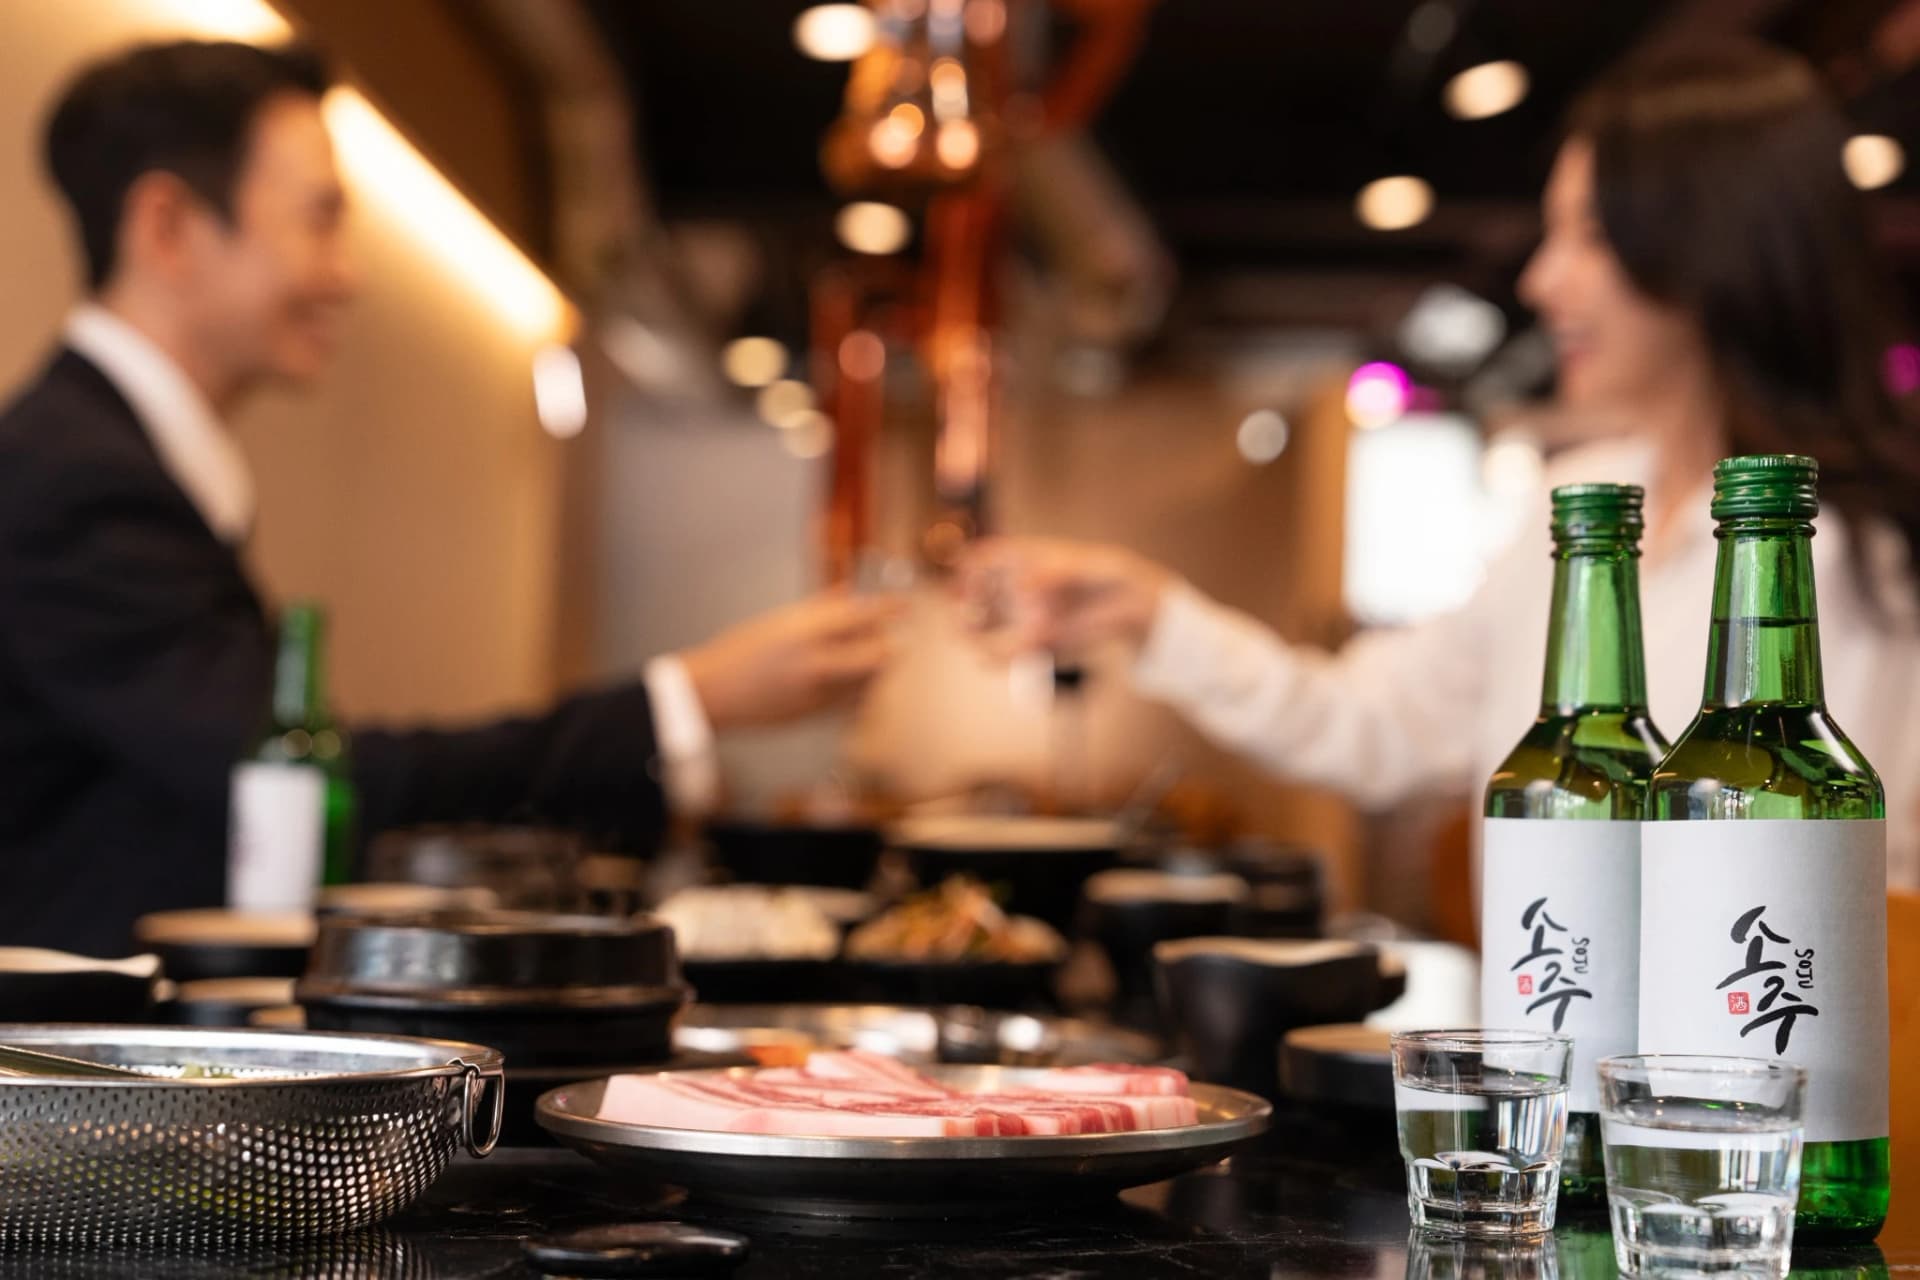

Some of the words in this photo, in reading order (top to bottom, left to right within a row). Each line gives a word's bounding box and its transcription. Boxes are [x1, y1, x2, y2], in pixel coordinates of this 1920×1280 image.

[1510, 897, 1593, 1033] 소주
[1571, 937, 1590, 974] SOJU
[1715, 905, 1819, 1056] 소주
[1794, 948, 1814, 989] SOJU
